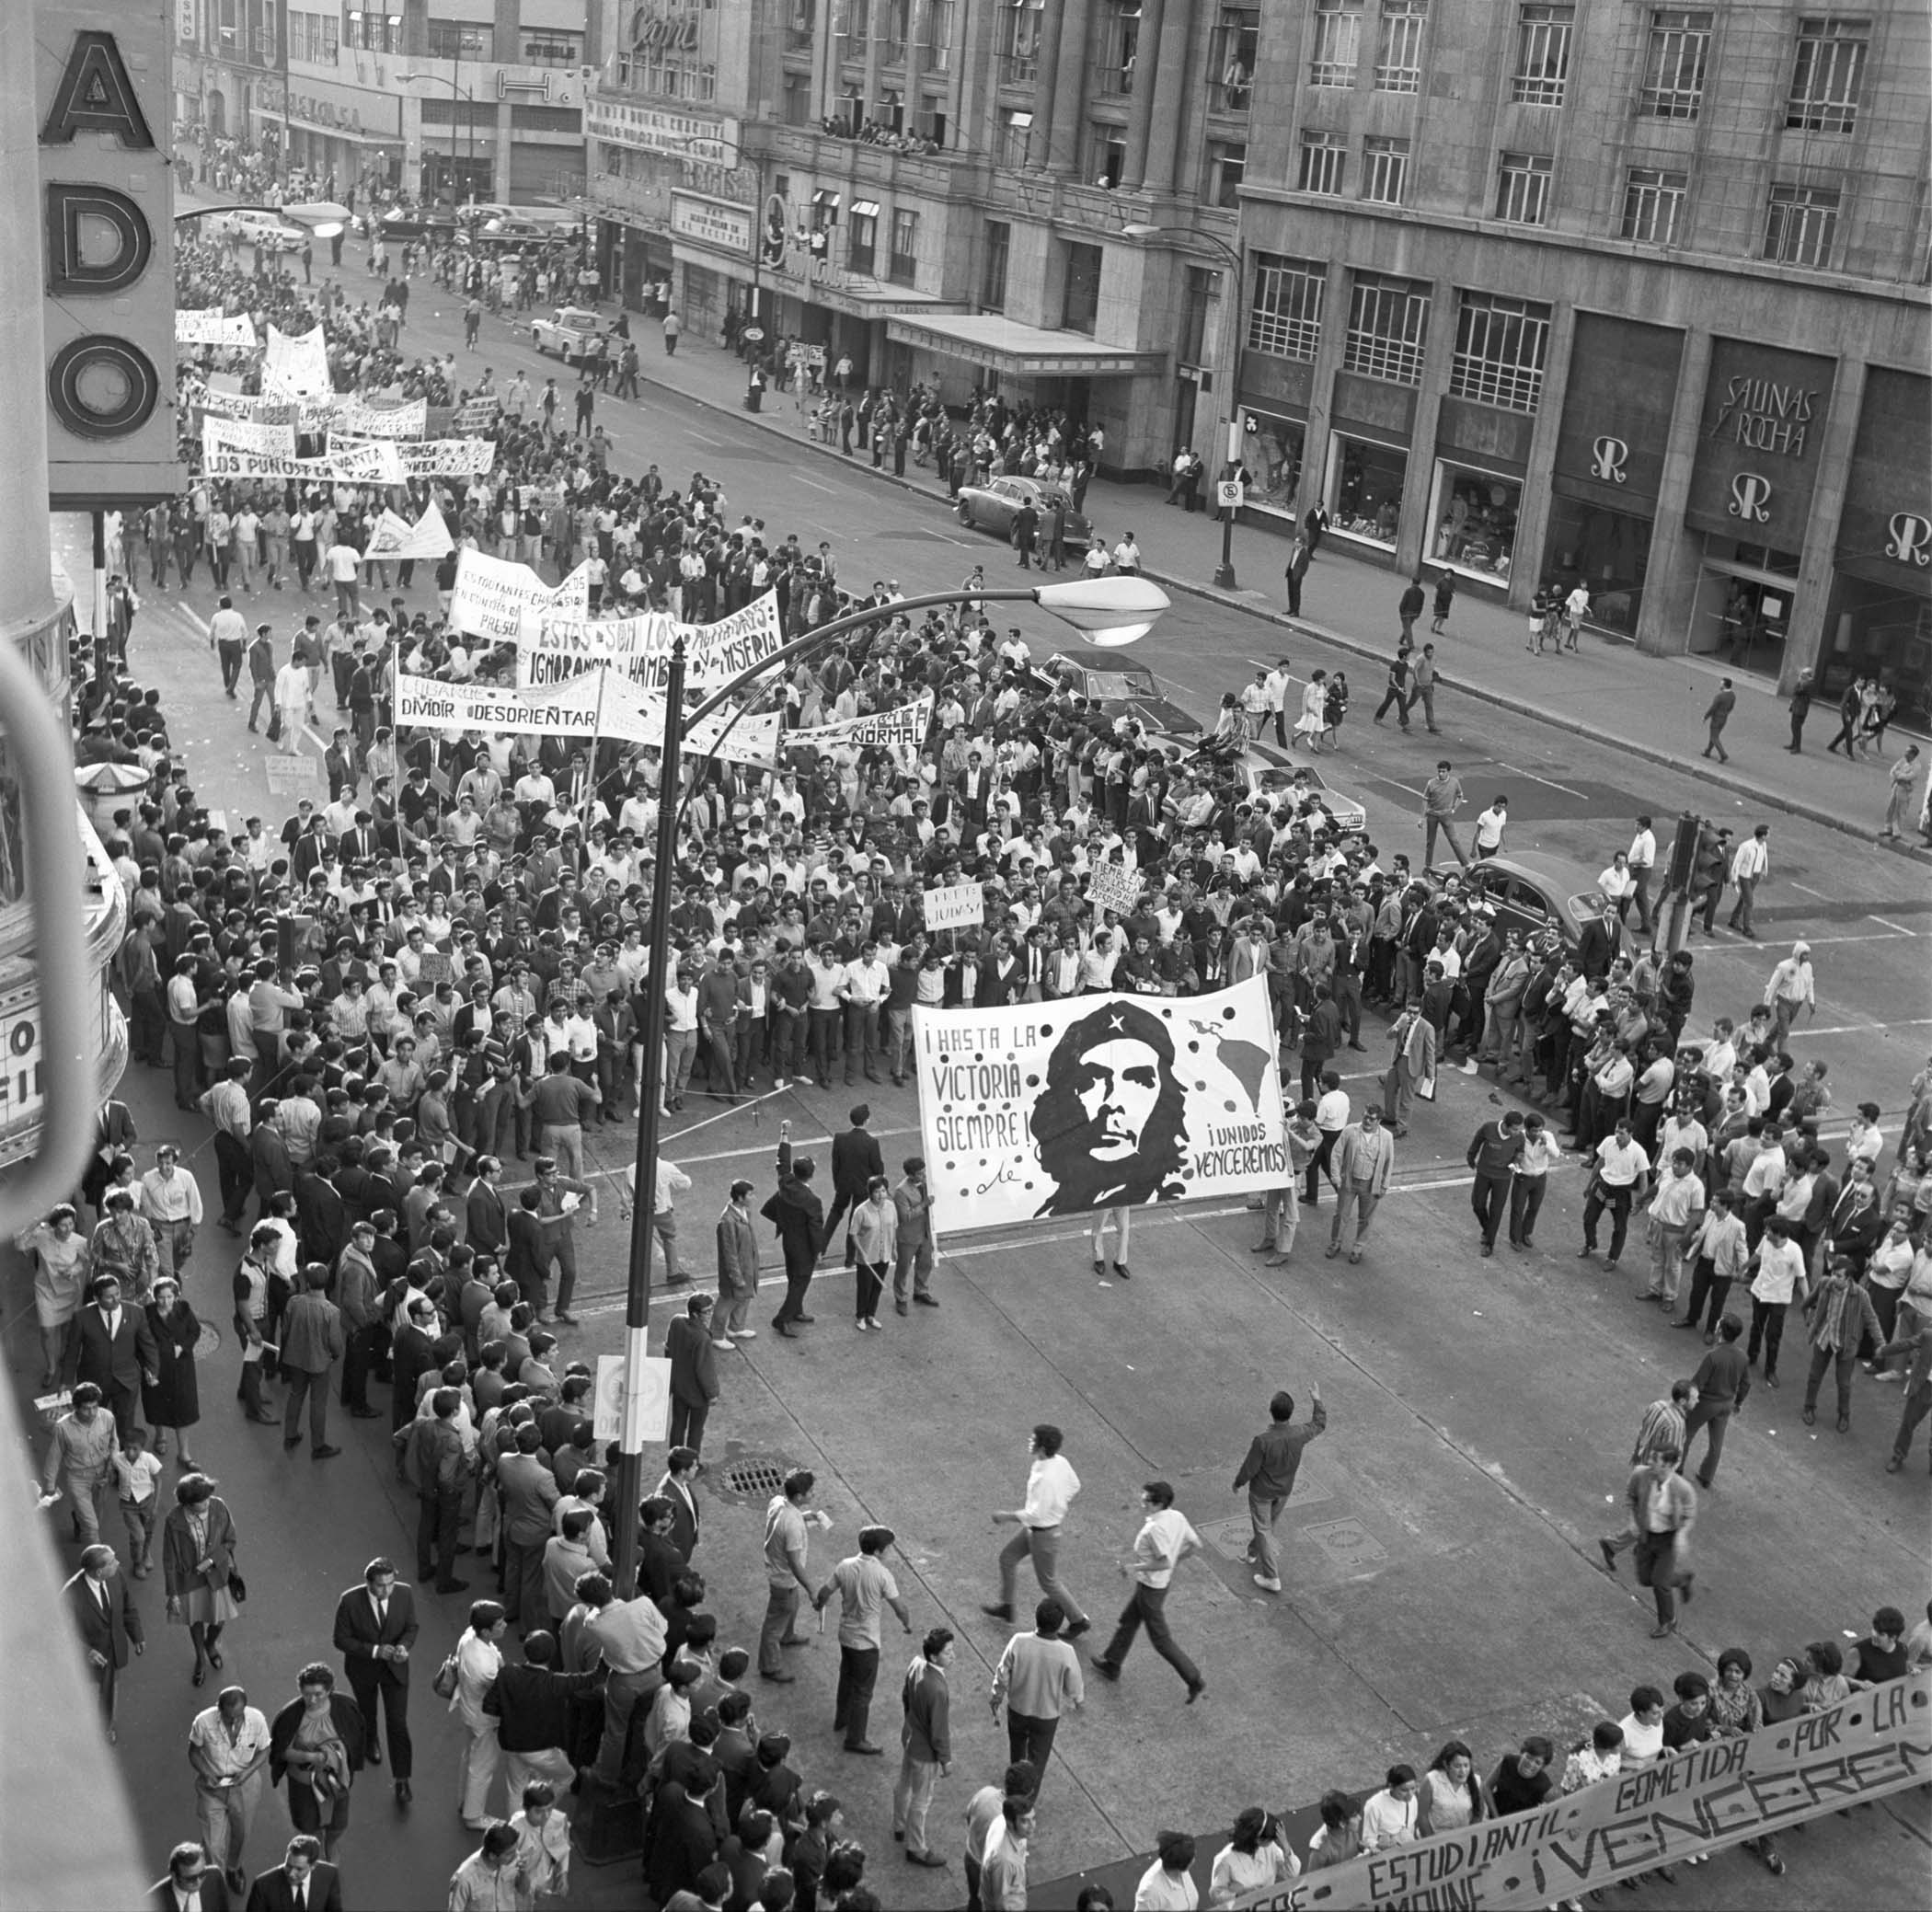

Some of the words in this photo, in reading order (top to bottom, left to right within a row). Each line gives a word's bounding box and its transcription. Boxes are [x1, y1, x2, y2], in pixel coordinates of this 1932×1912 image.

[38, 30, 157, 441] ADO
[1723, 375, 1819, 421] SALINAS
[1736, 412, 1805, 456] ROCHA
[852, 728, 923, 744] NORMAL
[1014, 1025, 1036, 1048] LA
[932, 1063, 1021, 1101] VICTORIA
[1194, 1143, 1286, 1179] VENCEREMOS
[1368, 1807, 1565, 1901] ESTUDIANTIL
[1793, 1706, 1841, 1758] POR
[1872, 1684, 1907, 1733] LA
